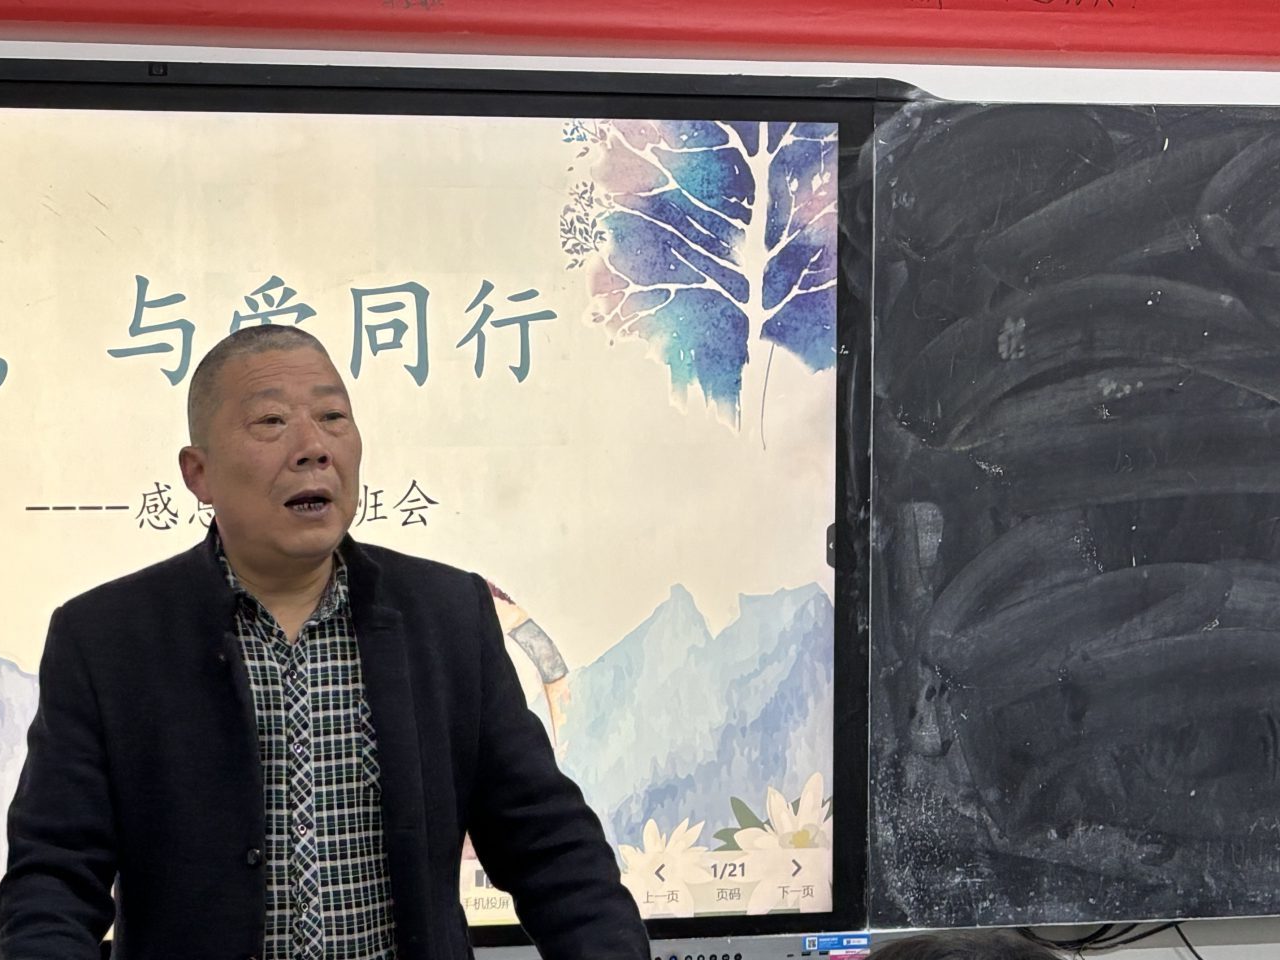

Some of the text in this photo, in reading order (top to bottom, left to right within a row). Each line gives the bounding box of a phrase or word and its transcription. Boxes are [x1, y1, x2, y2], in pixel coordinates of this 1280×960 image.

[710, 863, 746, 878] 1/21
[643, 890, 680, 904] 上一页
[716, 888, 741, 901] 页码
[778, 885, 814, 899] 下一页
